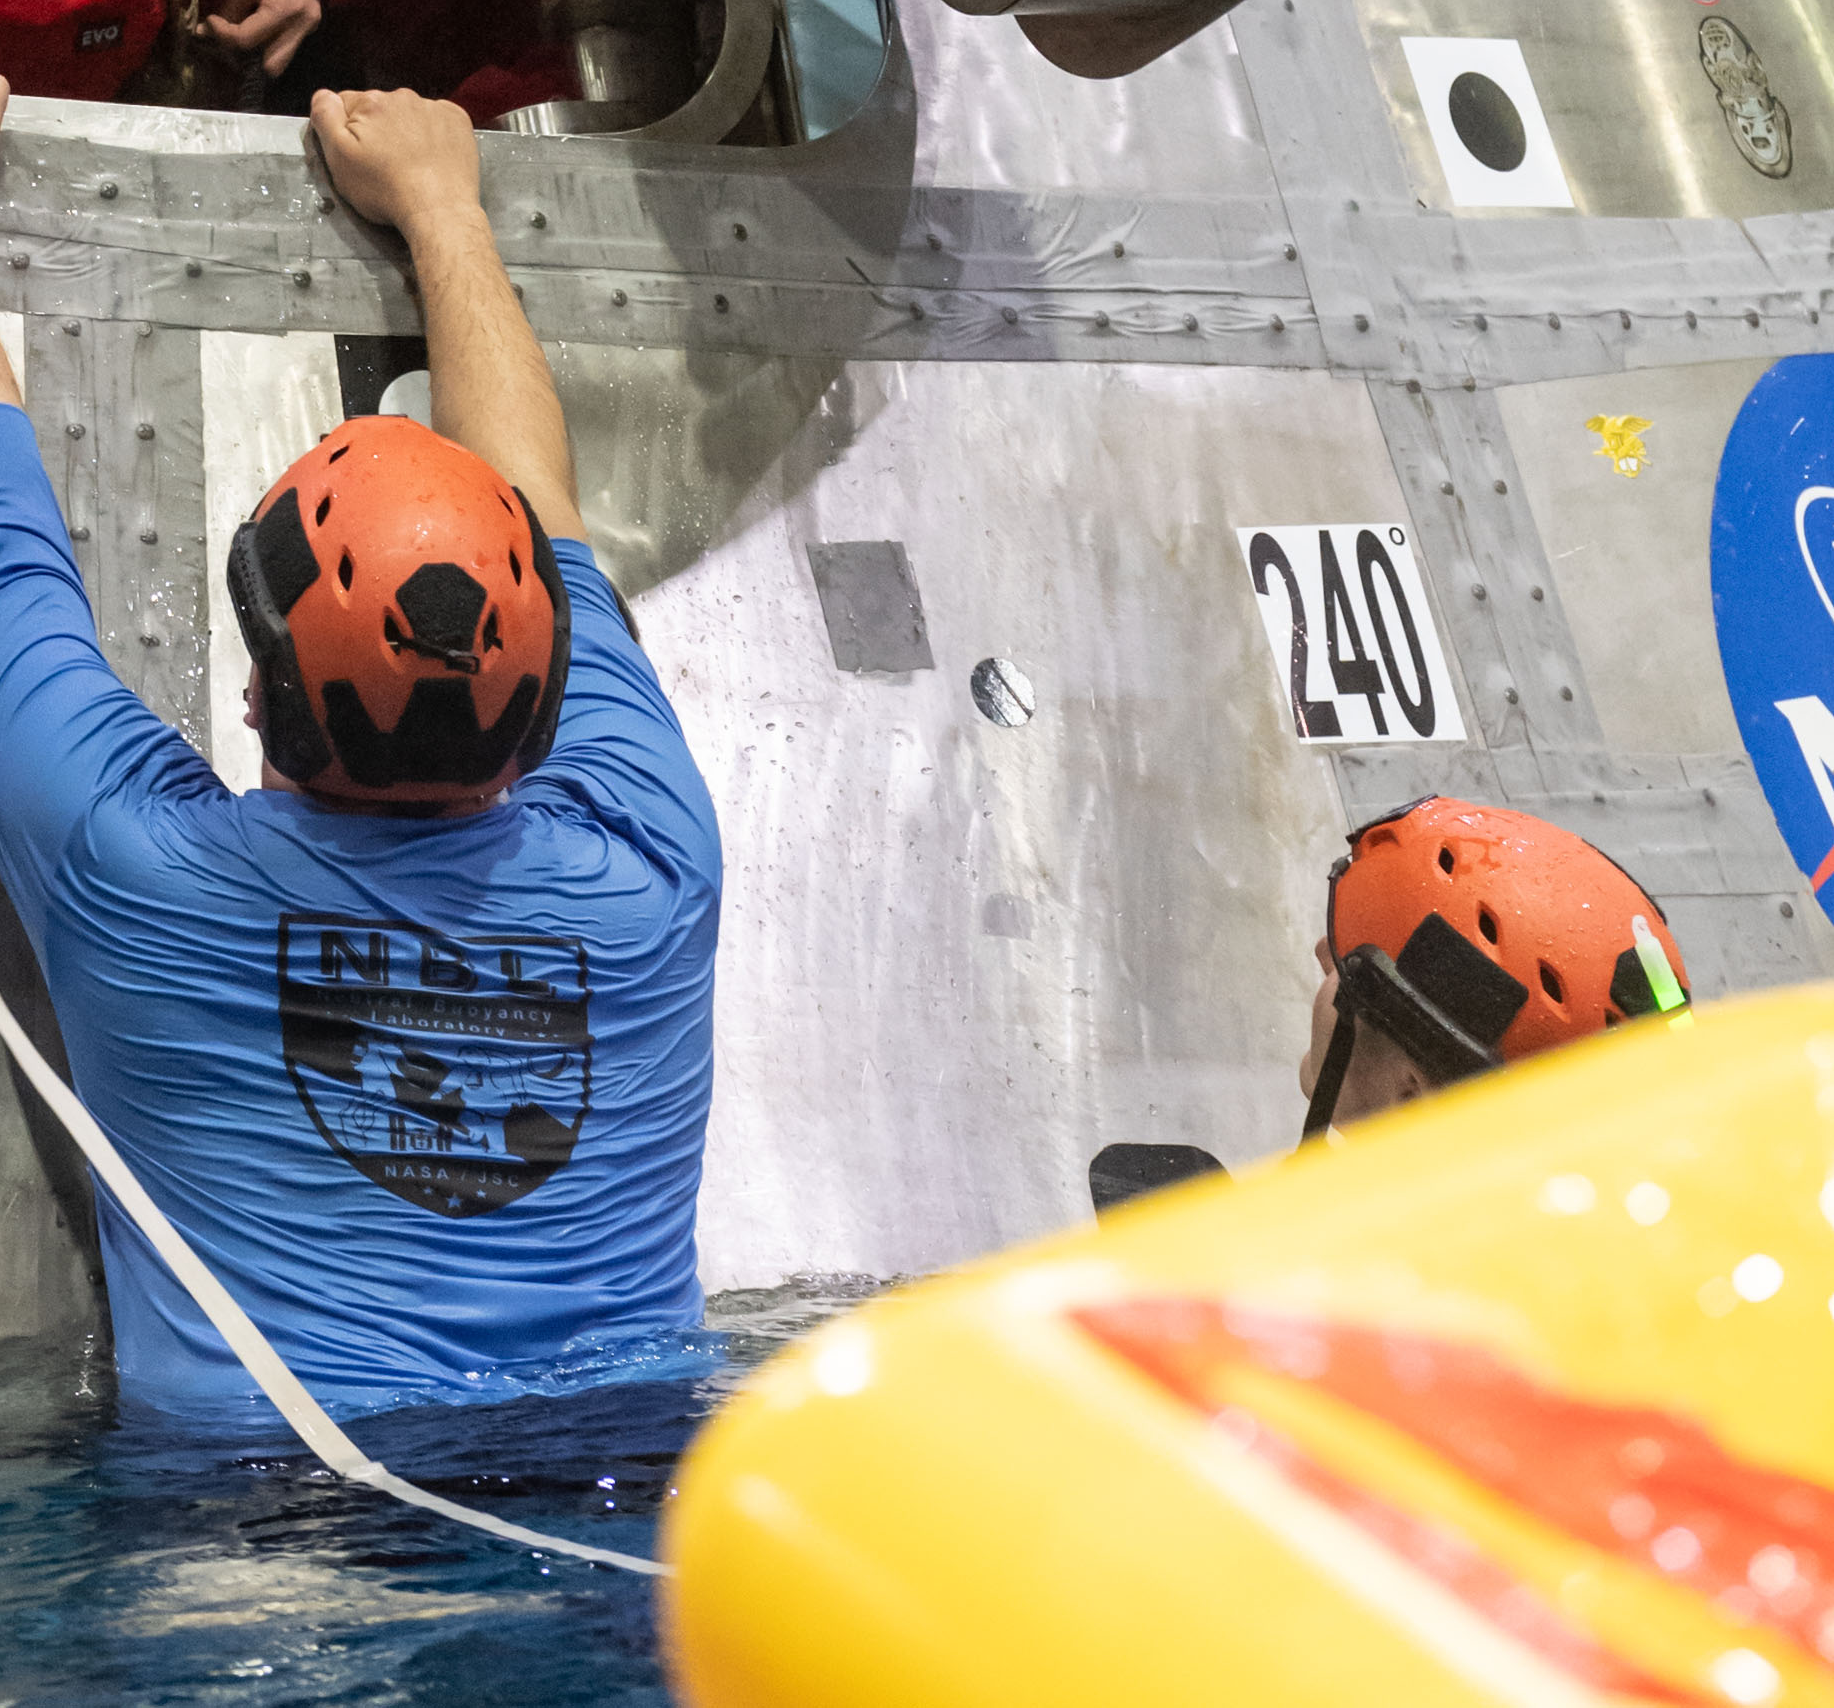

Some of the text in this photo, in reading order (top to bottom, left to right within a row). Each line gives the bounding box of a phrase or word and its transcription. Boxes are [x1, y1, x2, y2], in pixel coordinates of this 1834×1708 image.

[82, 25, 119, 46] EVO
[320, 931, 557, 999] NBL
[370, 1009, 508, 1037] Laboratory
[432, 997, 553, 1025] Buoyancy
[384, 1165, 449, 1181] NASA
[478, 1172, 519, 1188] JSC
